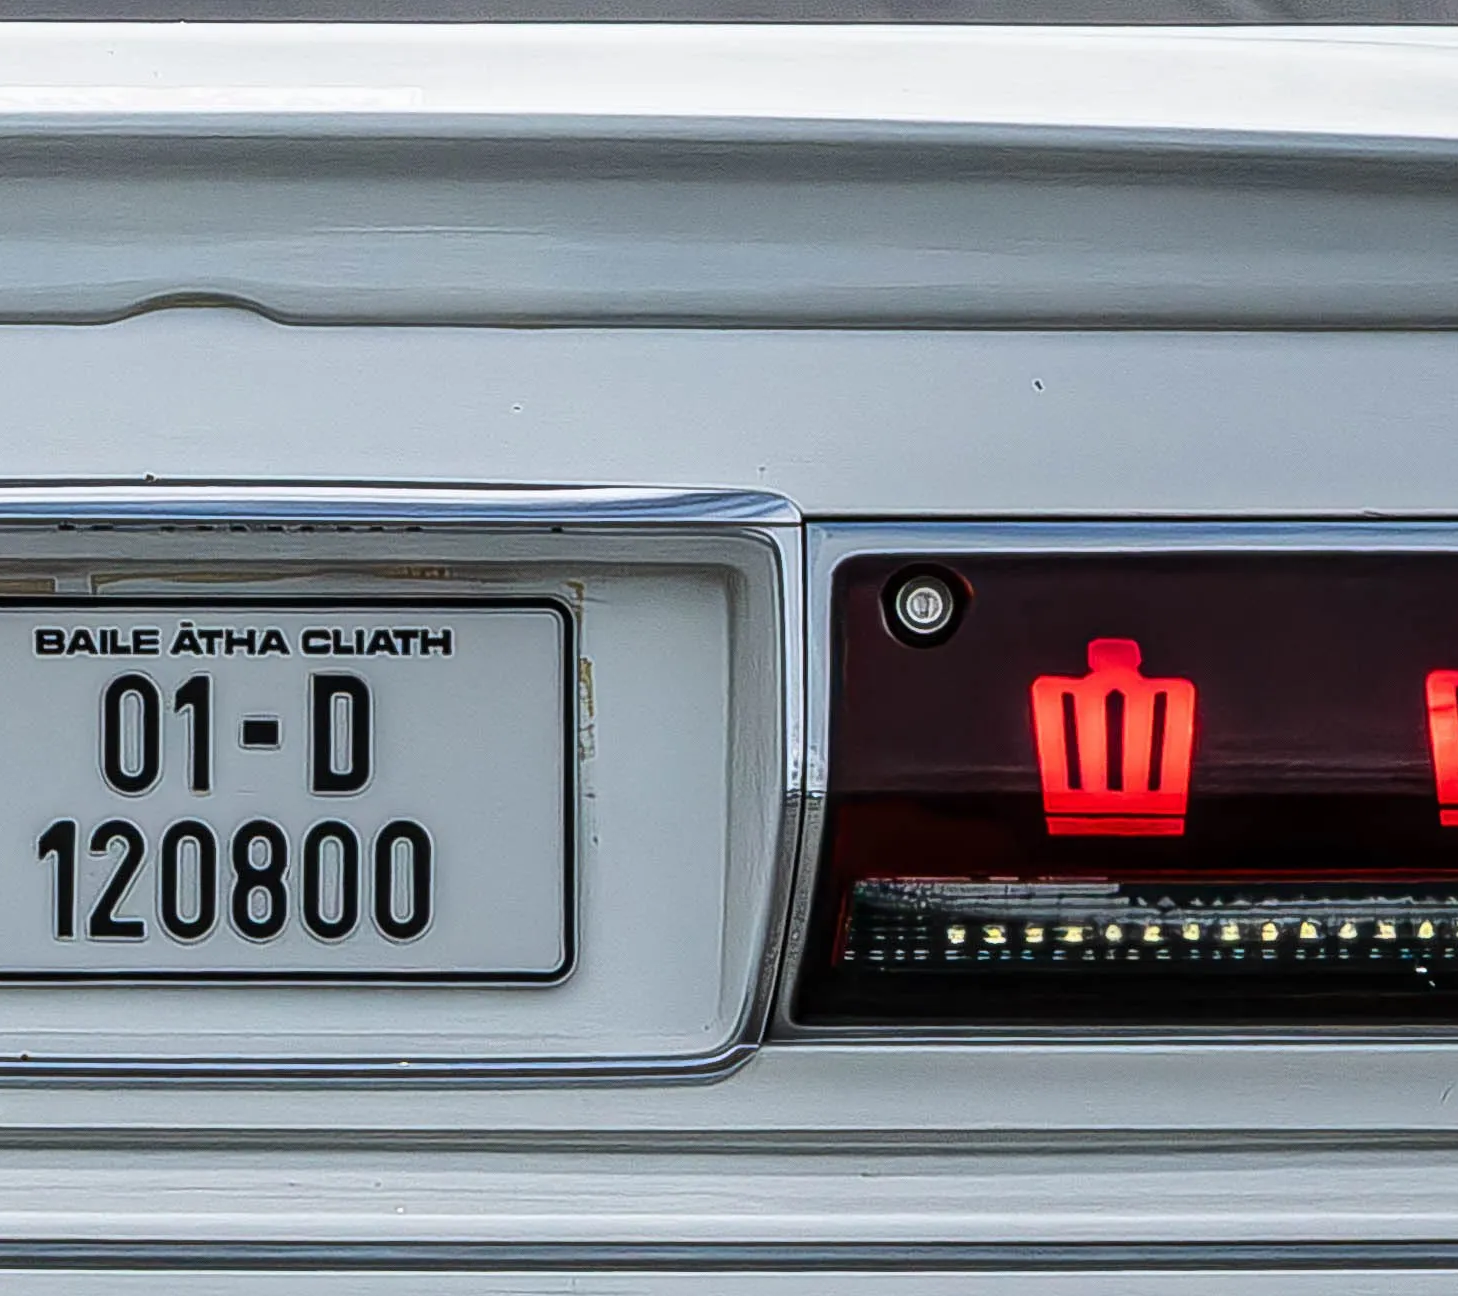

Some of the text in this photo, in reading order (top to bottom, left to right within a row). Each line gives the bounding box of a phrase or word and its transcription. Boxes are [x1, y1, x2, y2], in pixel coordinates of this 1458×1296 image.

[34, 628, 160, 656] BAILE
[301, 628, 453, 656] CLIATH
[37, 818, 433, 941] 120800
